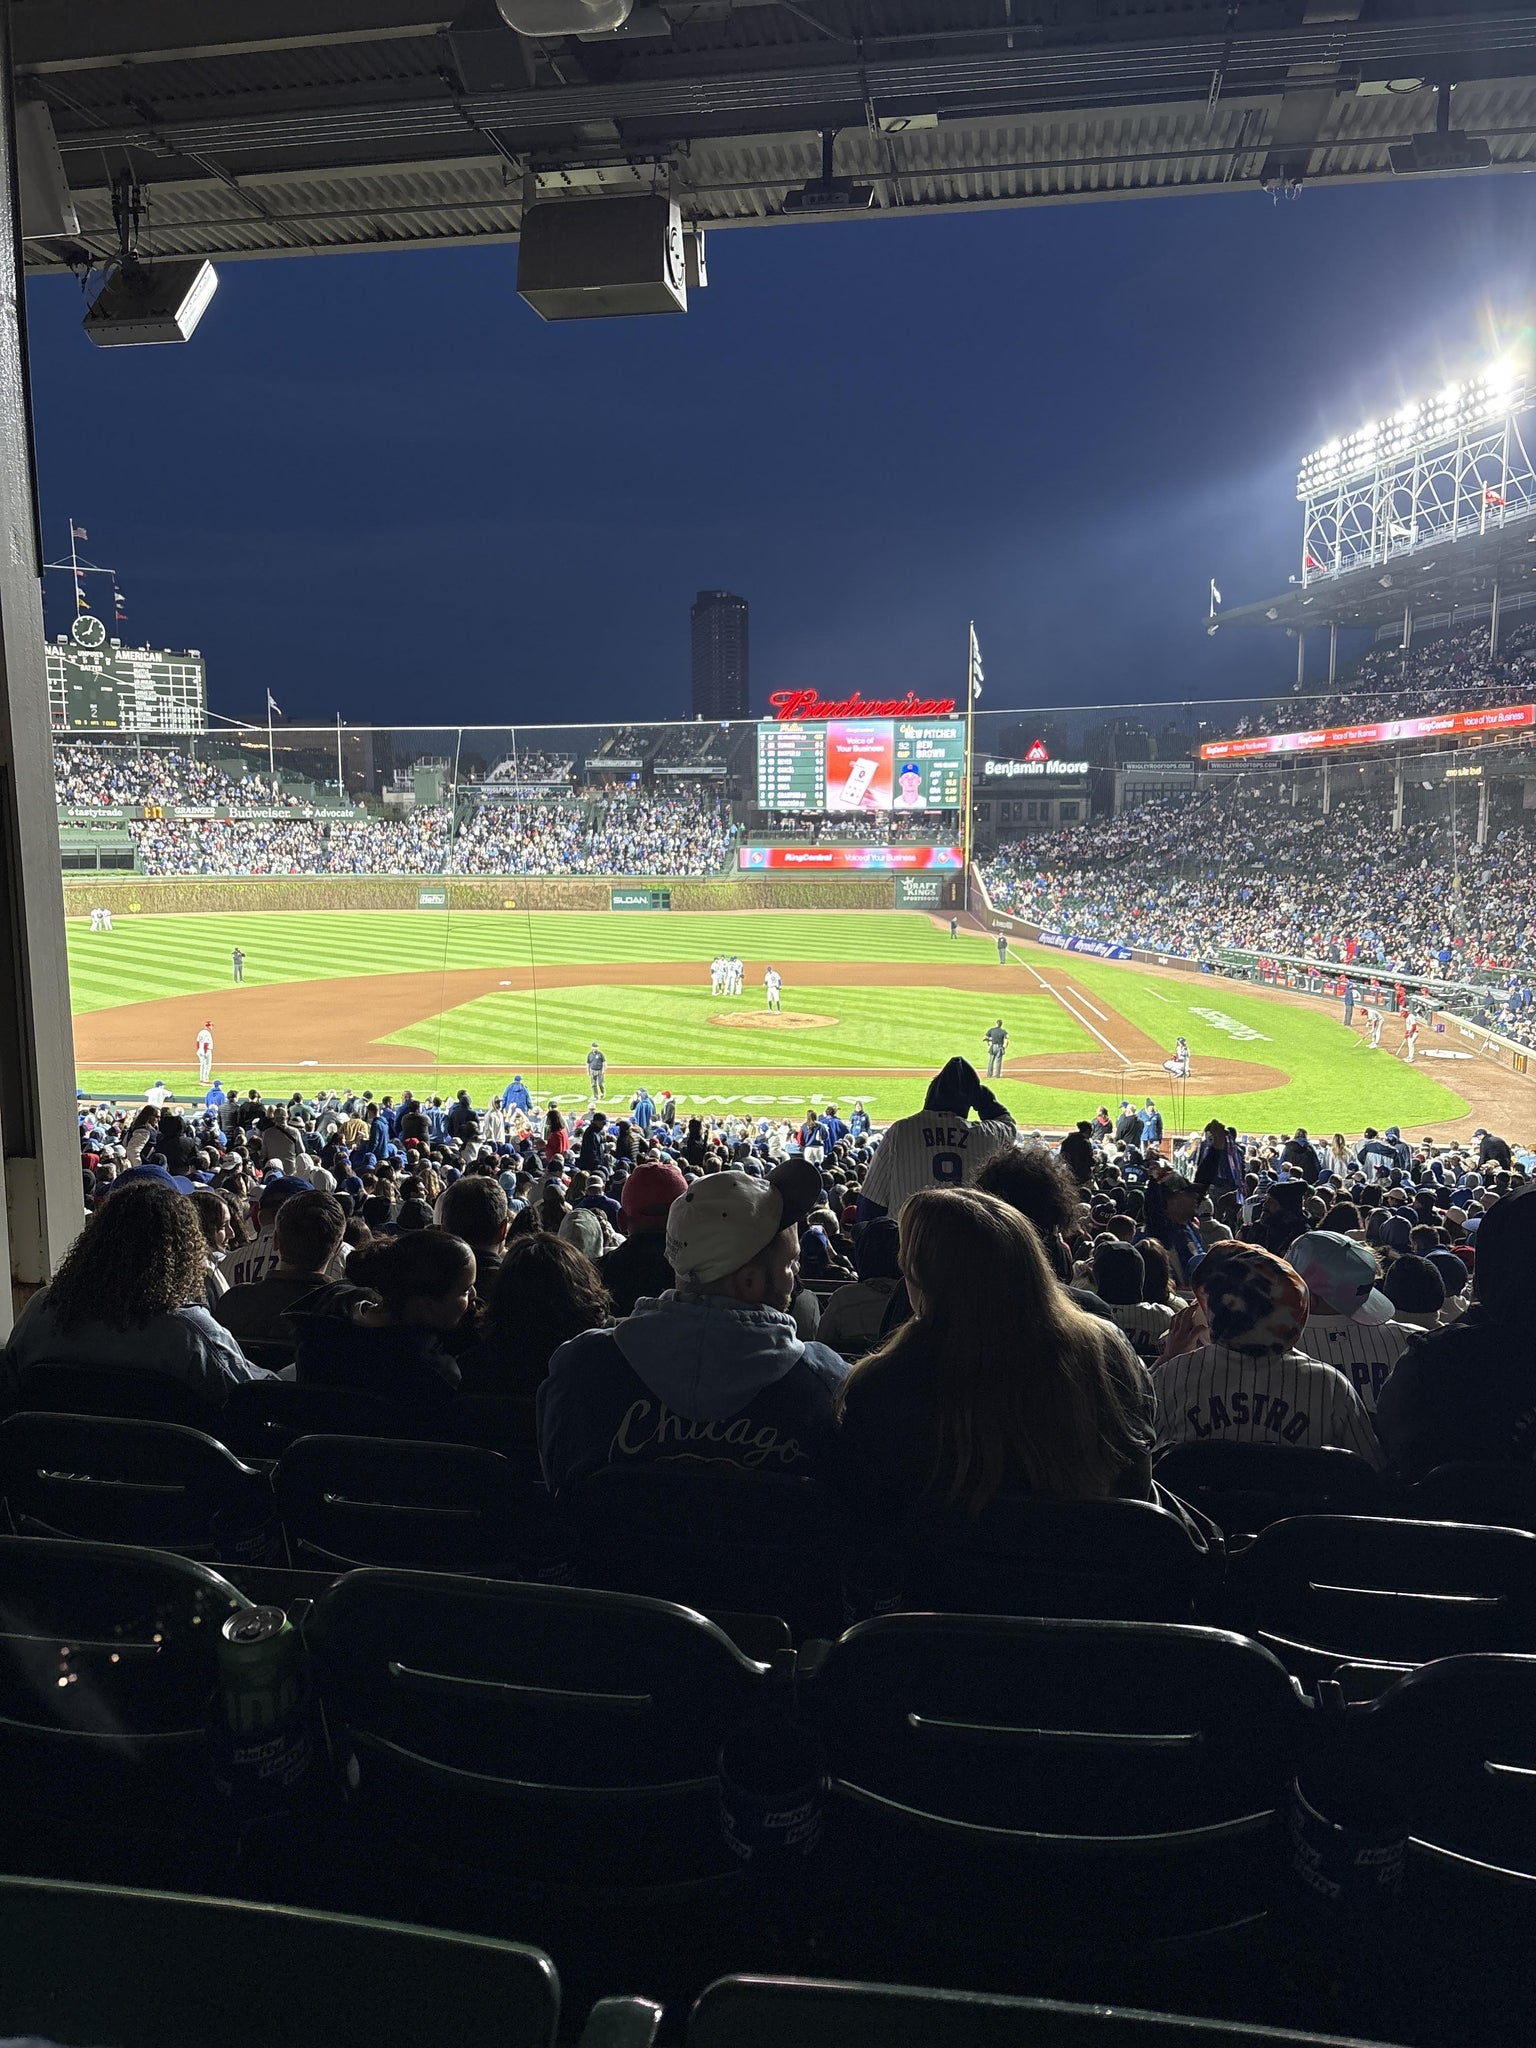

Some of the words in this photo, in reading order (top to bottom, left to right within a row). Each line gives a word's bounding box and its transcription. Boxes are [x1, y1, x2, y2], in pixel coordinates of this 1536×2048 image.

[115, 650, 162, 662] AMERICAN
[770, 688, 956, 721] Budweiser
[1418, 718, 1455, 732] RingCentral
[1463, 717, 1479, 727] Voice
[1485, 714, 1498, 724] Your
[1498, 711, 1525, 722] Business
[923, 729, 957, 739] PITCHER
[1298, 733, 1326, 745] RingCentral
[1357, 729, 1377, 738] Business
[846, 737, 866, 745] Voice
[836, 745, 852, 753] Your
[985, 760, 1044, 777] Benjamin
[1046, 759, 1089, 775] Moore
[1211, 761, 1278, 769] WRIGLEYROOFTOPS.COM
[75, 807, 123, 818] tastytrade
[174, 807, 216, 815] GRAINGER
[314, 808, 354, 818] Advocate
[785, 853, 833, 862] RingCentral
[844, 853, 861, 862] Voice
[870, 853, 886, 861] Your
[886, 854, 917, 862] Business
[903, 882, 938, 890] DRAFT
[1187, 1392, 1311, 1444] CASTRO
[608, 1399, 809, 1466] Chicago
